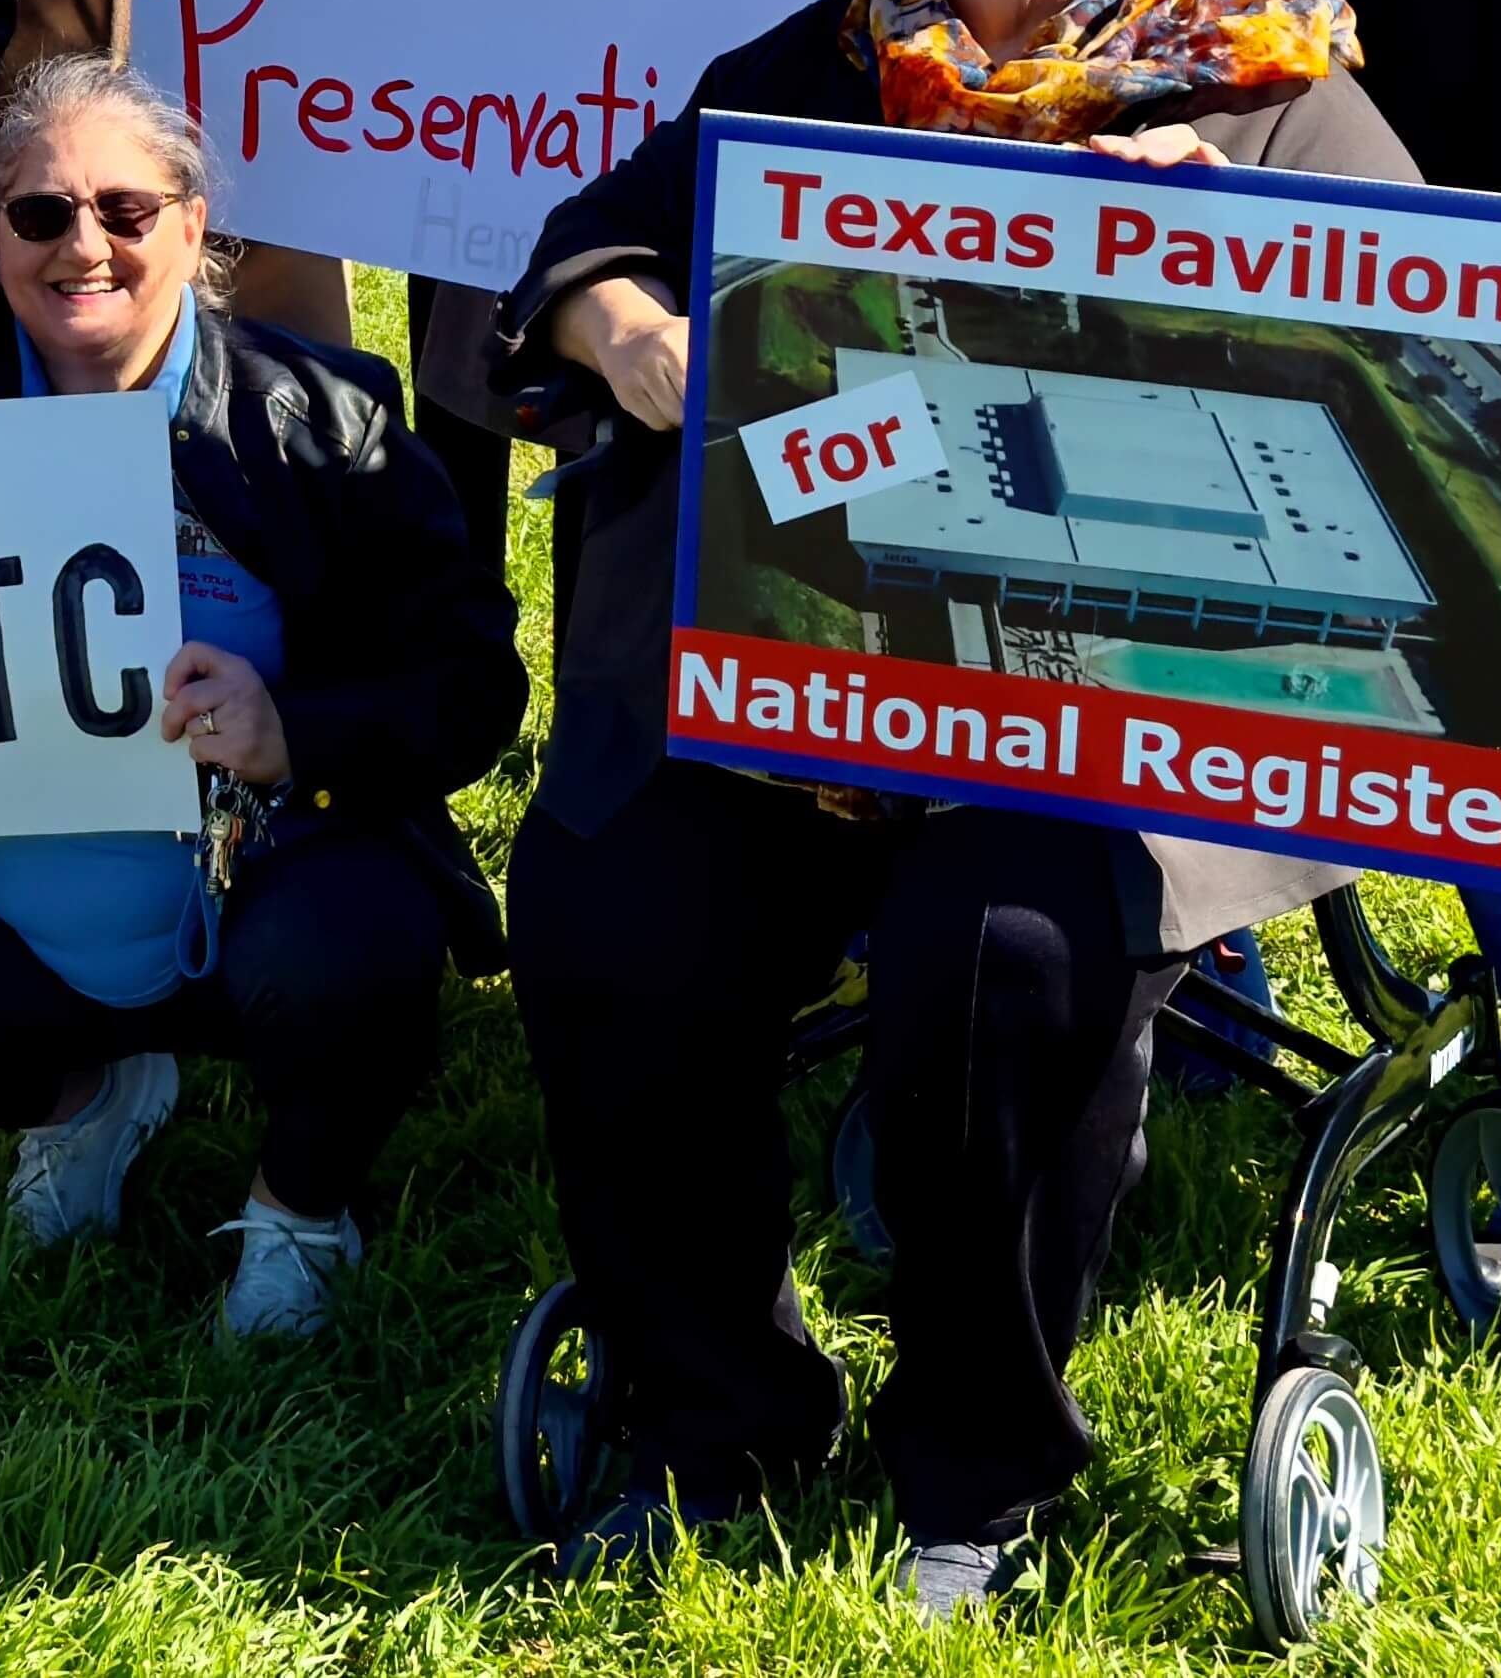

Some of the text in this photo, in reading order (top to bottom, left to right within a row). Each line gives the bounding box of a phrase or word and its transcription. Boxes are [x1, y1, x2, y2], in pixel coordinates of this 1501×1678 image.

[419, 177, 534, 270] Hem
[764, 171, 1055, 268] Texas
[782, 414, 904, 495] for
[677, 651, 1079, 776] National
